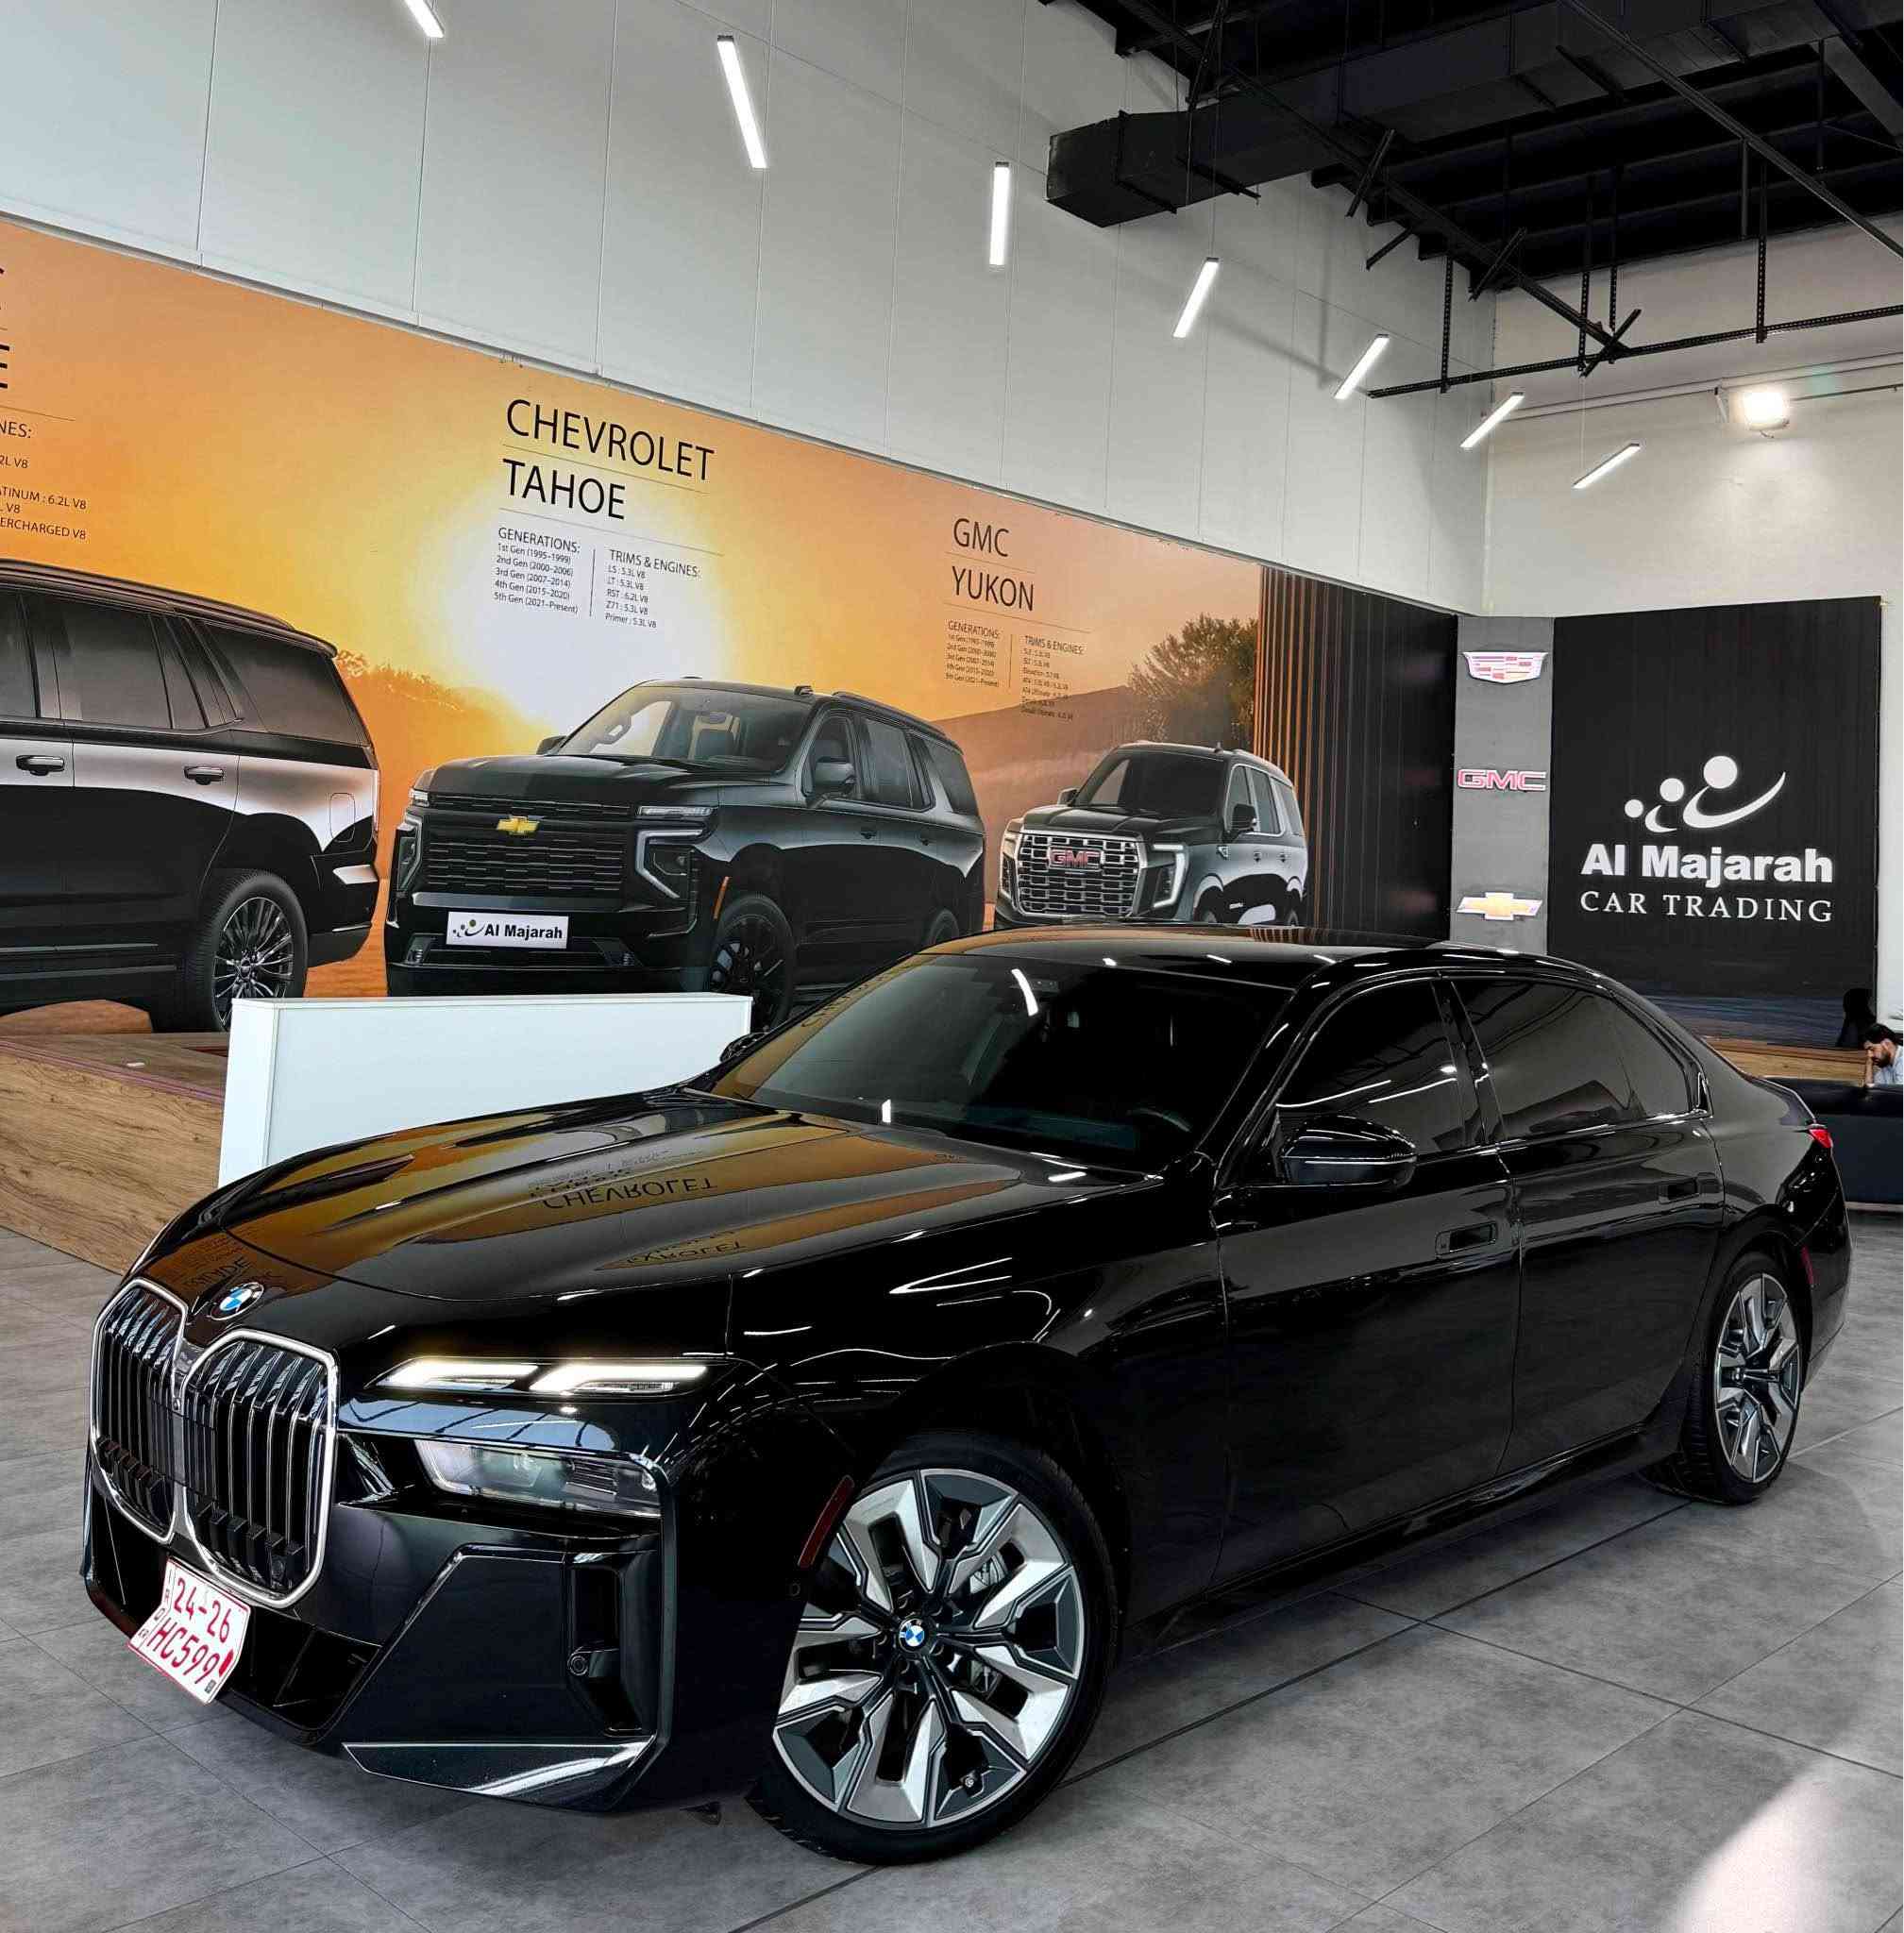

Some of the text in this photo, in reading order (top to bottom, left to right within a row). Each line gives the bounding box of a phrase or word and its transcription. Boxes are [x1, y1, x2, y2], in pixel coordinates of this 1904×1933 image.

[507, 399, 715, 480] CHEVROLET
[14, 457, 28, 469] V8
[0, 486, 40, 501] TINUM
[73, 497, 87, 511] V8
[502, 458, 625, 520] TAHOE
[7, 502, 21, 513] V8
[73, 529, 87, 540] V8
[498, 527, 581, 553] GENERATIONS:
[953, 518, 1009, 557] GMC
[497, 555, 511, 564] 2nd
[513, 558, 528, 567] Gen
[498, 543, 508, 552] 1st
[511, 545, 525, 555] Gen
[496, 567, 508, 577] 3rd
[510, 570, 525, 580] Gen
[609, 549, 700, 578] TRIMS & ENGINES:
[494, 591, 507, 601] 5th
[509, 594, 523, 604] Gen
[495, 580, 507, 589] 4th
[510, 581, 524, 592] Gen
[952, 565, 1034, 611] YUKON
[1457, 768, 1546, 792] GMC
[1580, 844, 1833, 888] Al Majarah
[1579, 890, 1832, 923] CAR TRADING
[484, 923, 563, 941] Al Majarah
[174, 1577, 232, 1643] 24-26
[146, 1617, 221, 1685] HC599
